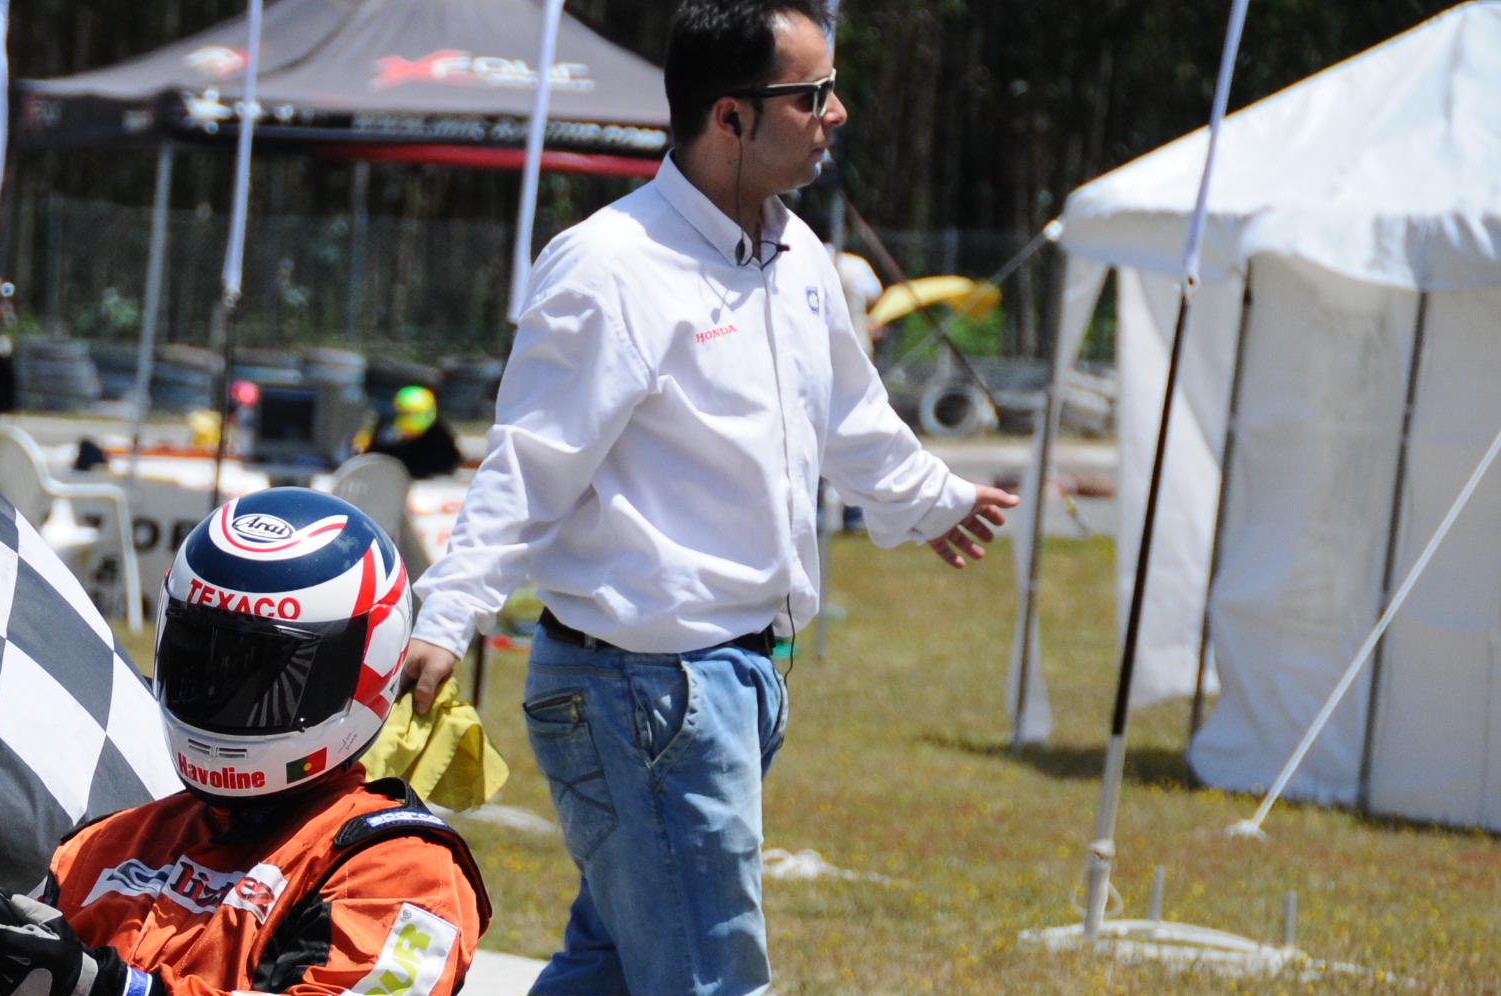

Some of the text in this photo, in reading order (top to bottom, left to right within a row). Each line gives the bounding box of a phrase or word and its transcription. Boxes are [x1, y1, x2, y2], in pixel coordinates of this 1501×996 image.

[695, 324, 737, 344] HONDA
[236, 516, 287, 535] Arai
[186, 578, 301, 621] TEXACO
[178, 752, 265, 790] Havoline
